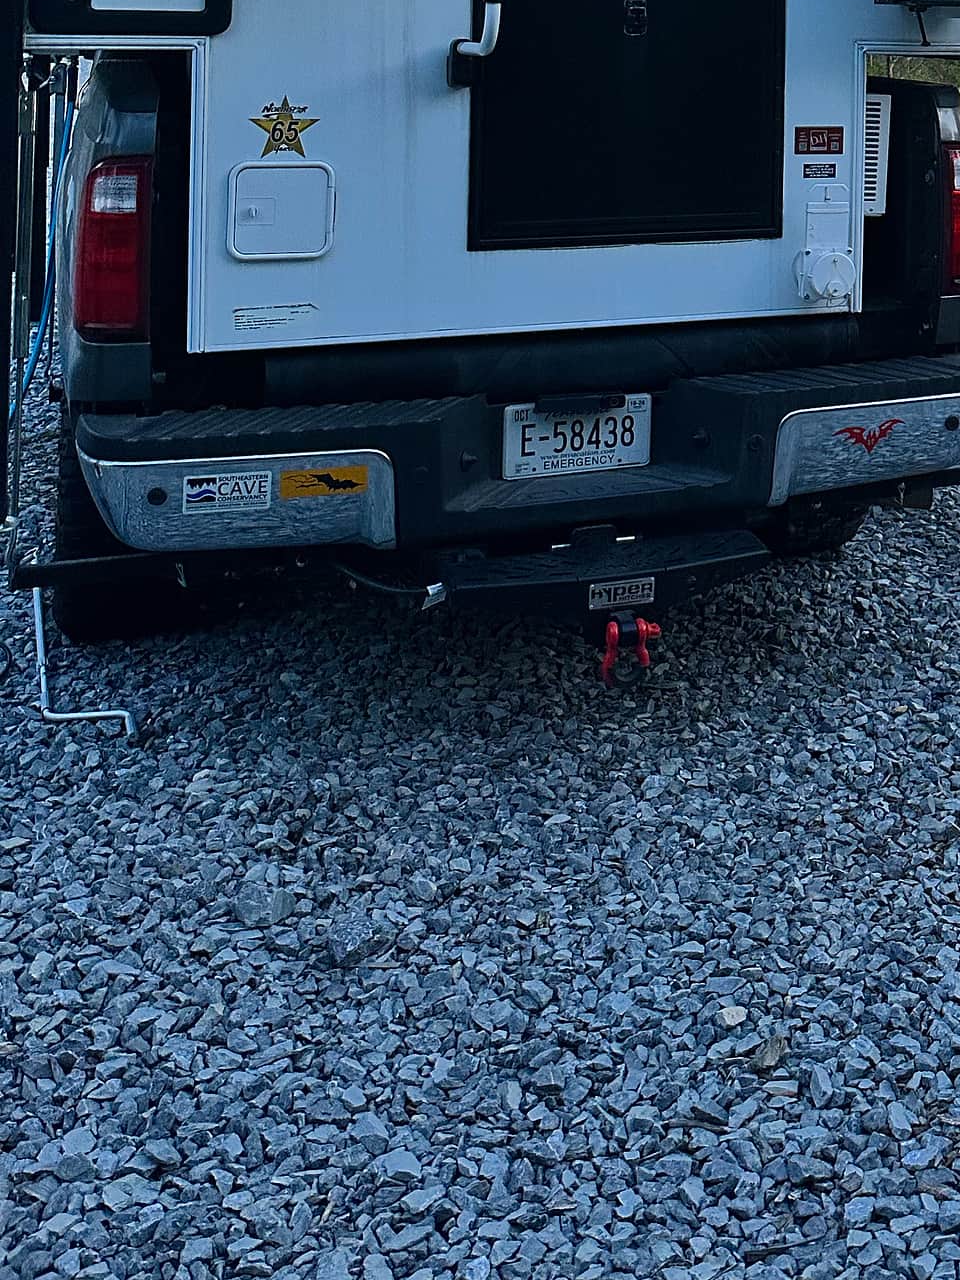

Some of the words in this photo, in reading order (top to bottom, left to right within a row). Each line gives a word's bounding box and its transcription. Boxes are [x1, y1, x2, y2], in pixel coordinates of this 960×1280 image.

[271, 121, 299, 142] 65
[514, 409, 529, 422] OCT
[520, 415, 635, 458] E-58438
[543, 455, 615, 470] EMERGENCY
[218, 474, 269, 482] SOUTHEASTERN
[218, 480, 268, 496] CAVE
[217, 494, 267, 502] CONSERVANCY
